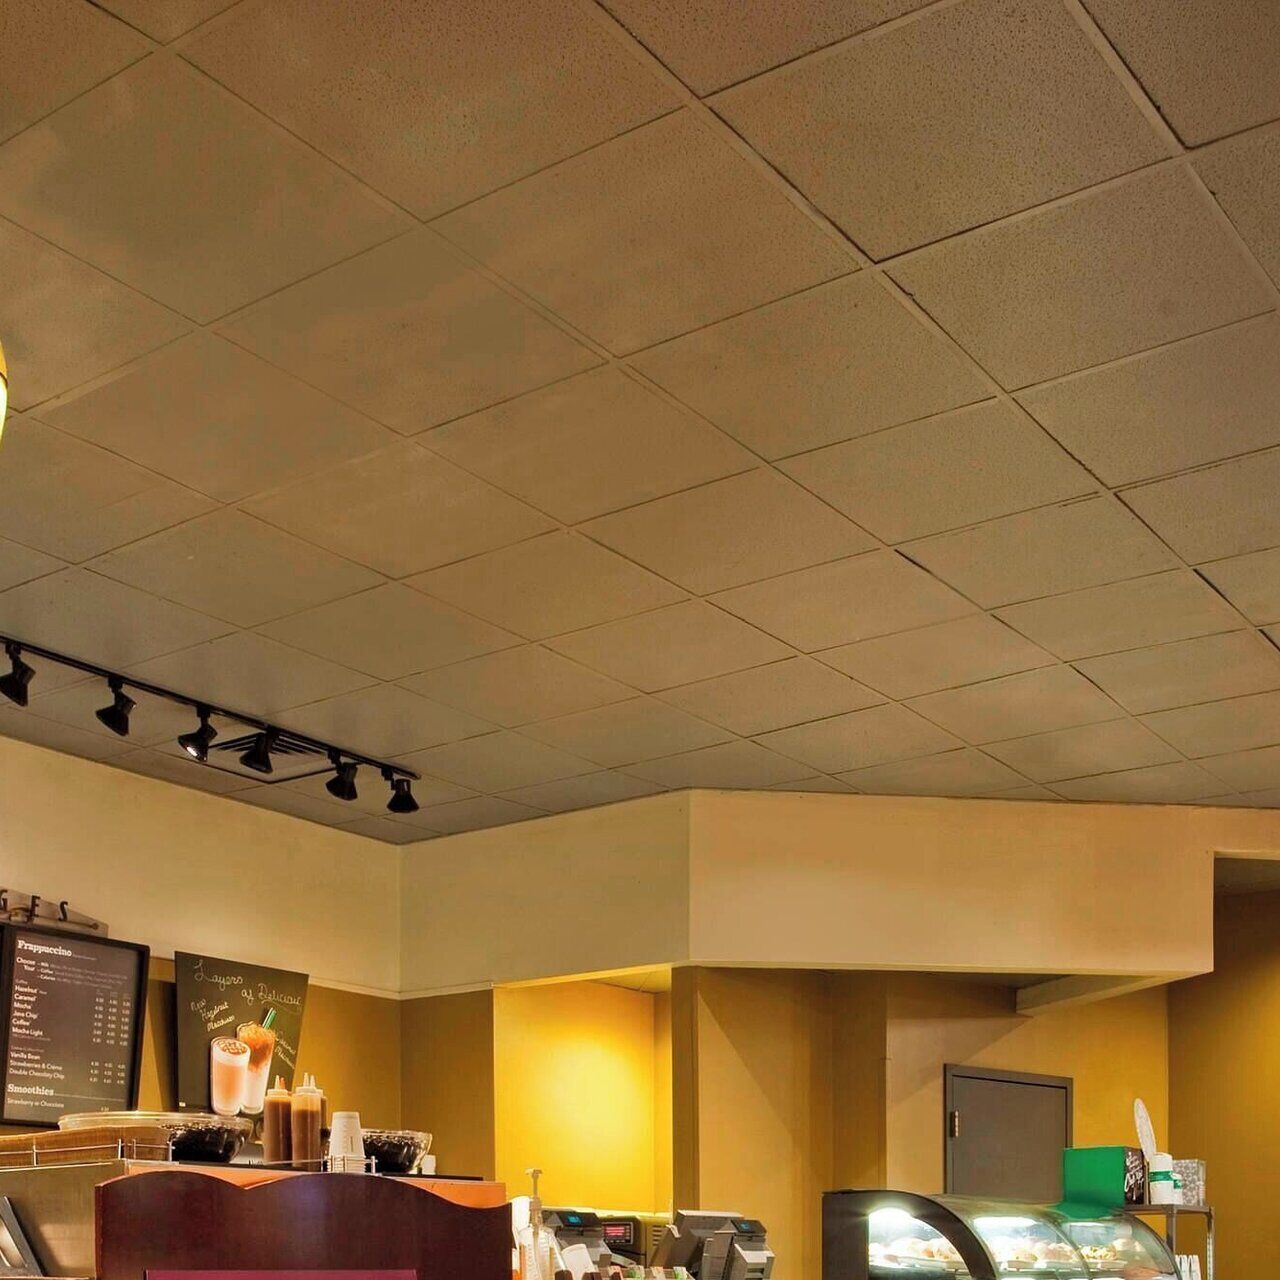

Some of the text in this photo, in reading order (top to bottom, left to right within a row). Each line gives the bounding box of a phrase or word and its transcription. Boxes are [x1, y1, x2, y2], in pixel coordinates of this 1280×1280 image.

[17, 940, 73, 957] Frappuccino
[16, 957, 36, 966] Choose
[7, 1083, 55, 1097] Smoothies
[7, 1098, 65, 1108] Strawberry Chocolate
